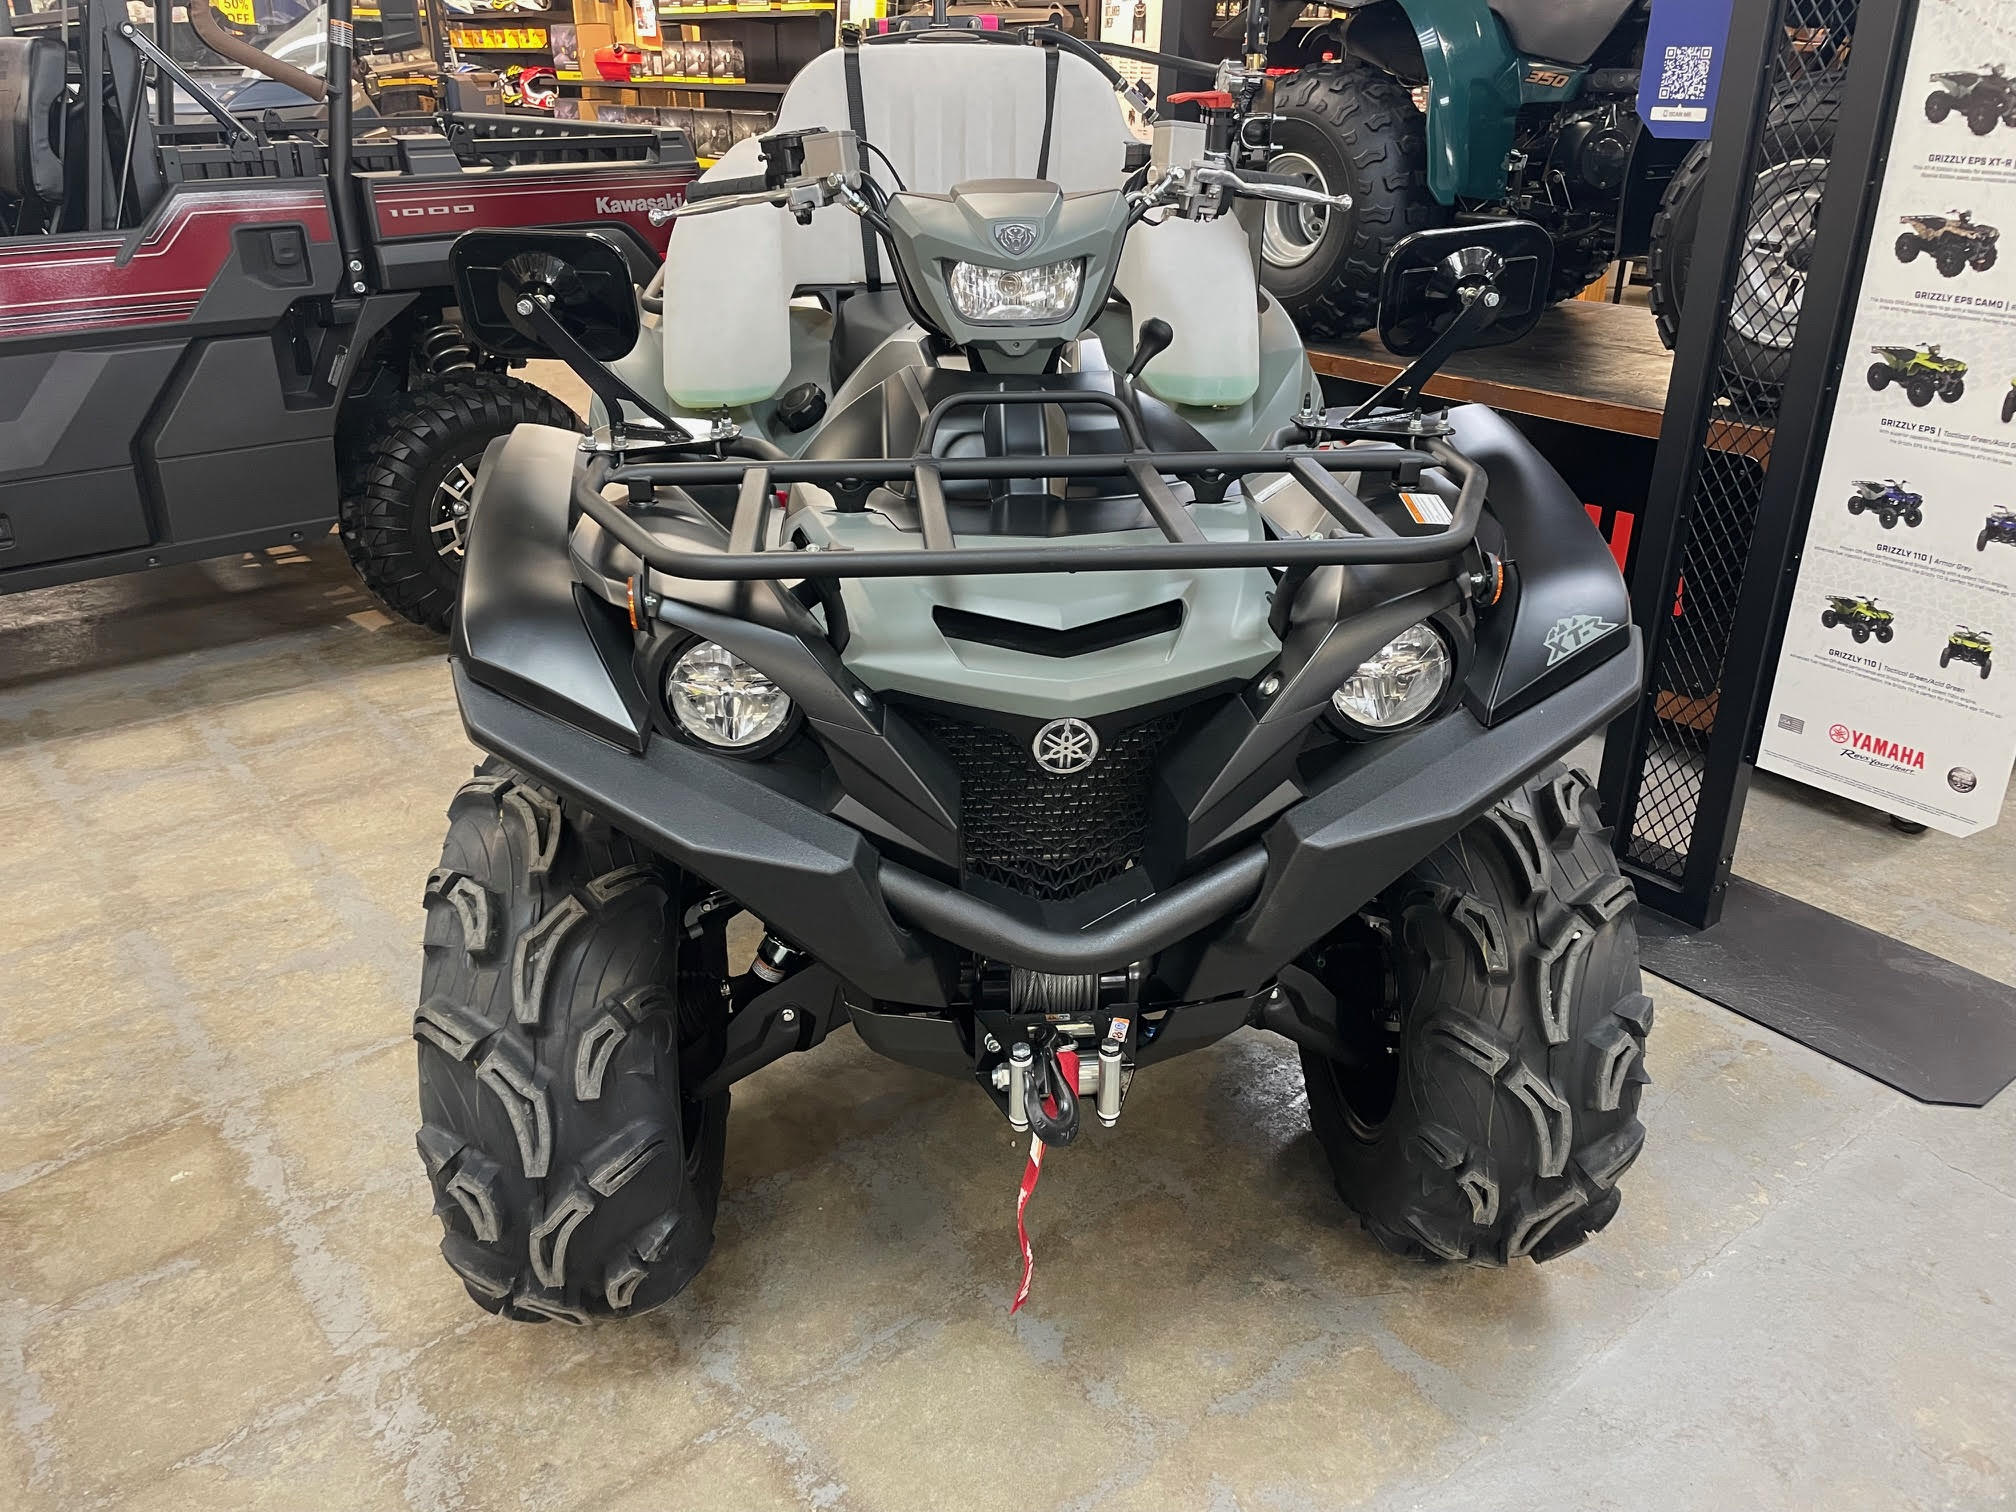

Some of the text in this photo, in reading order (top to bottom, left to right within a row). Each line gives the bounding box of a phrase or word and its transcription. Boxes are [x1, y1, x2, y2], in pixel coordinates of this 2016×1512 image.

[1524, 70, 1570, 88] 350
[1928, 154, 1967, 164] GRIZZLY
[1968, 156, 1987, 166] EPS
[1988, 158, 2013, 167] XT-R
[389, 204, 475, 217] 1000
[595, 193, 683, 214] Kawasaki
[1914, 290, 1953, 302] GRIZZLY
[1954, 295, 1973, 305] EPS
[1975, 298, 2003, 309] CAMO
[1880, 418, 1918, 431] GRIZZLY
[1918, 424, 1936, 434] EPS
[1876, 543, 1912, 558] GRIZZLY
[1913, 552, 1928, 562] 110
[1934, 558, 1956, 568] Armor
[1545, 617, 1613, 662] XT-R
[1828, 648, 1863, 663] GRIZZLY
[1864, 658, 1877, 668] 110
[1945, 683, 1966, 694] Green
[1852, 729, 1925, 769] YAMAHA
[1840, 747, 1915, 774] Revs Your Heart
